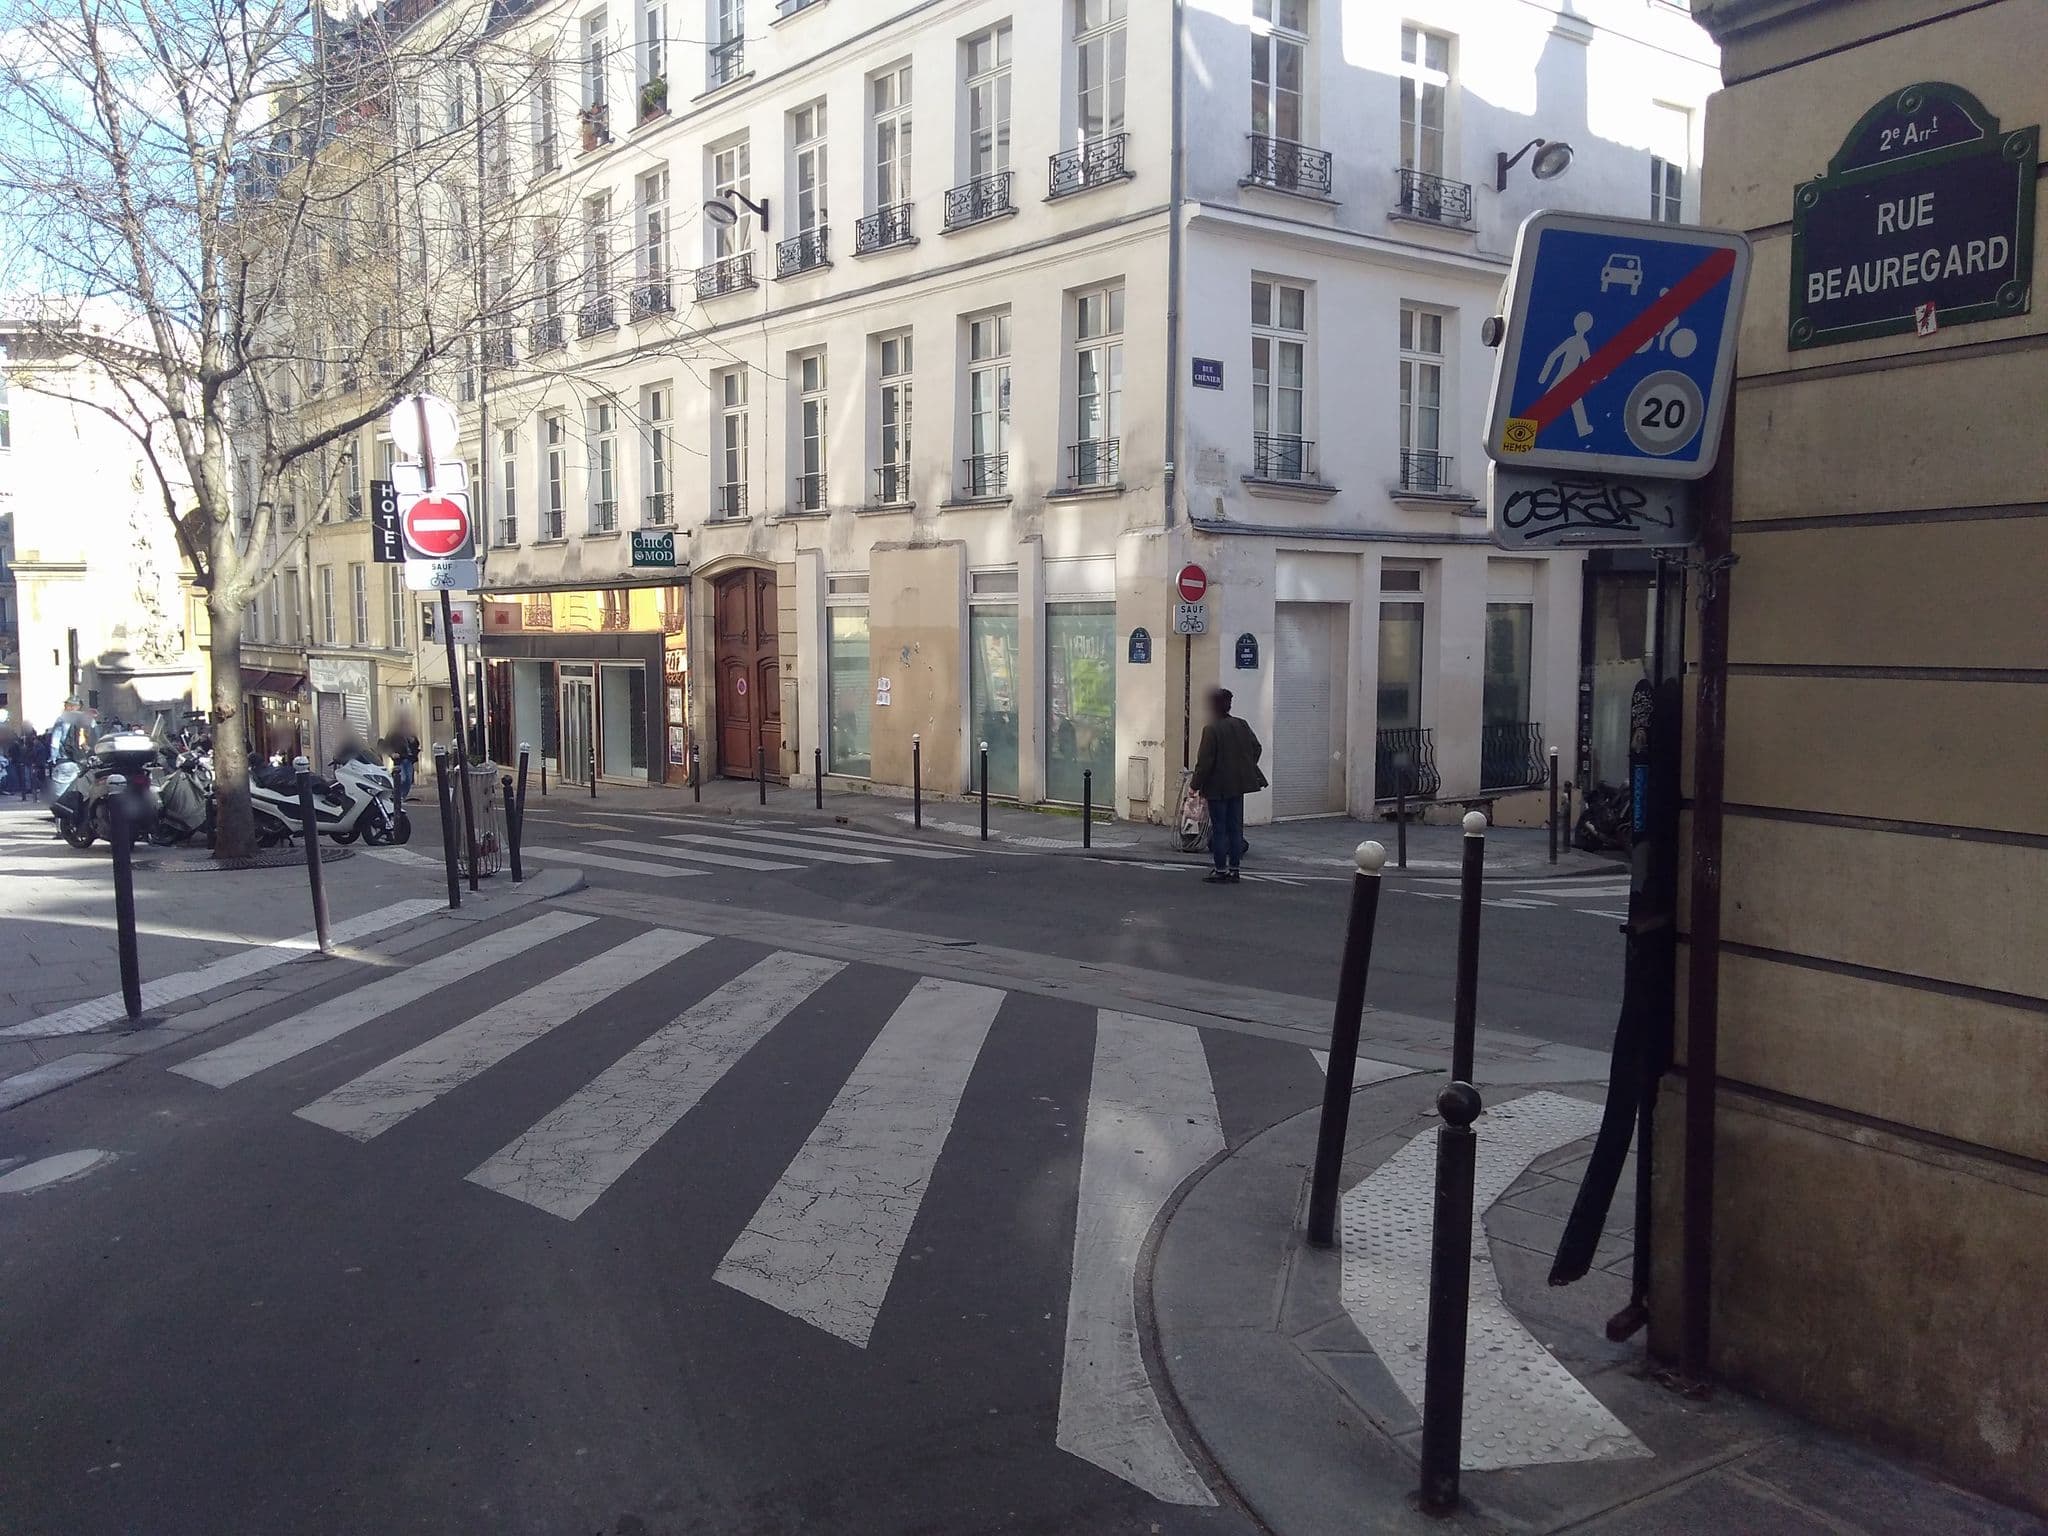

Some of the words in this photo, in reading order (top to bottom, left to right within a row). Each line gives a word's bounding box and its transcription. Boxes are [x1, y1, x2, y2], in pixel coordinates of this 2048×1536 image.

[1876, 192, 1935, 235] RUE
[1807, 236, 2009, 304] BEAUREGARD
[1640, 397, 1686, 429] 20
[1502, 442, 1533, 453] HEMSY
[381, 484, 396, 560] HOTEL
[633, 538, 672, 549] CHICO
[645, 551, 673, 561] MOD
[431, 563, 453, 571] SAUF
[1180, 605, 1204, 614] SAUF
